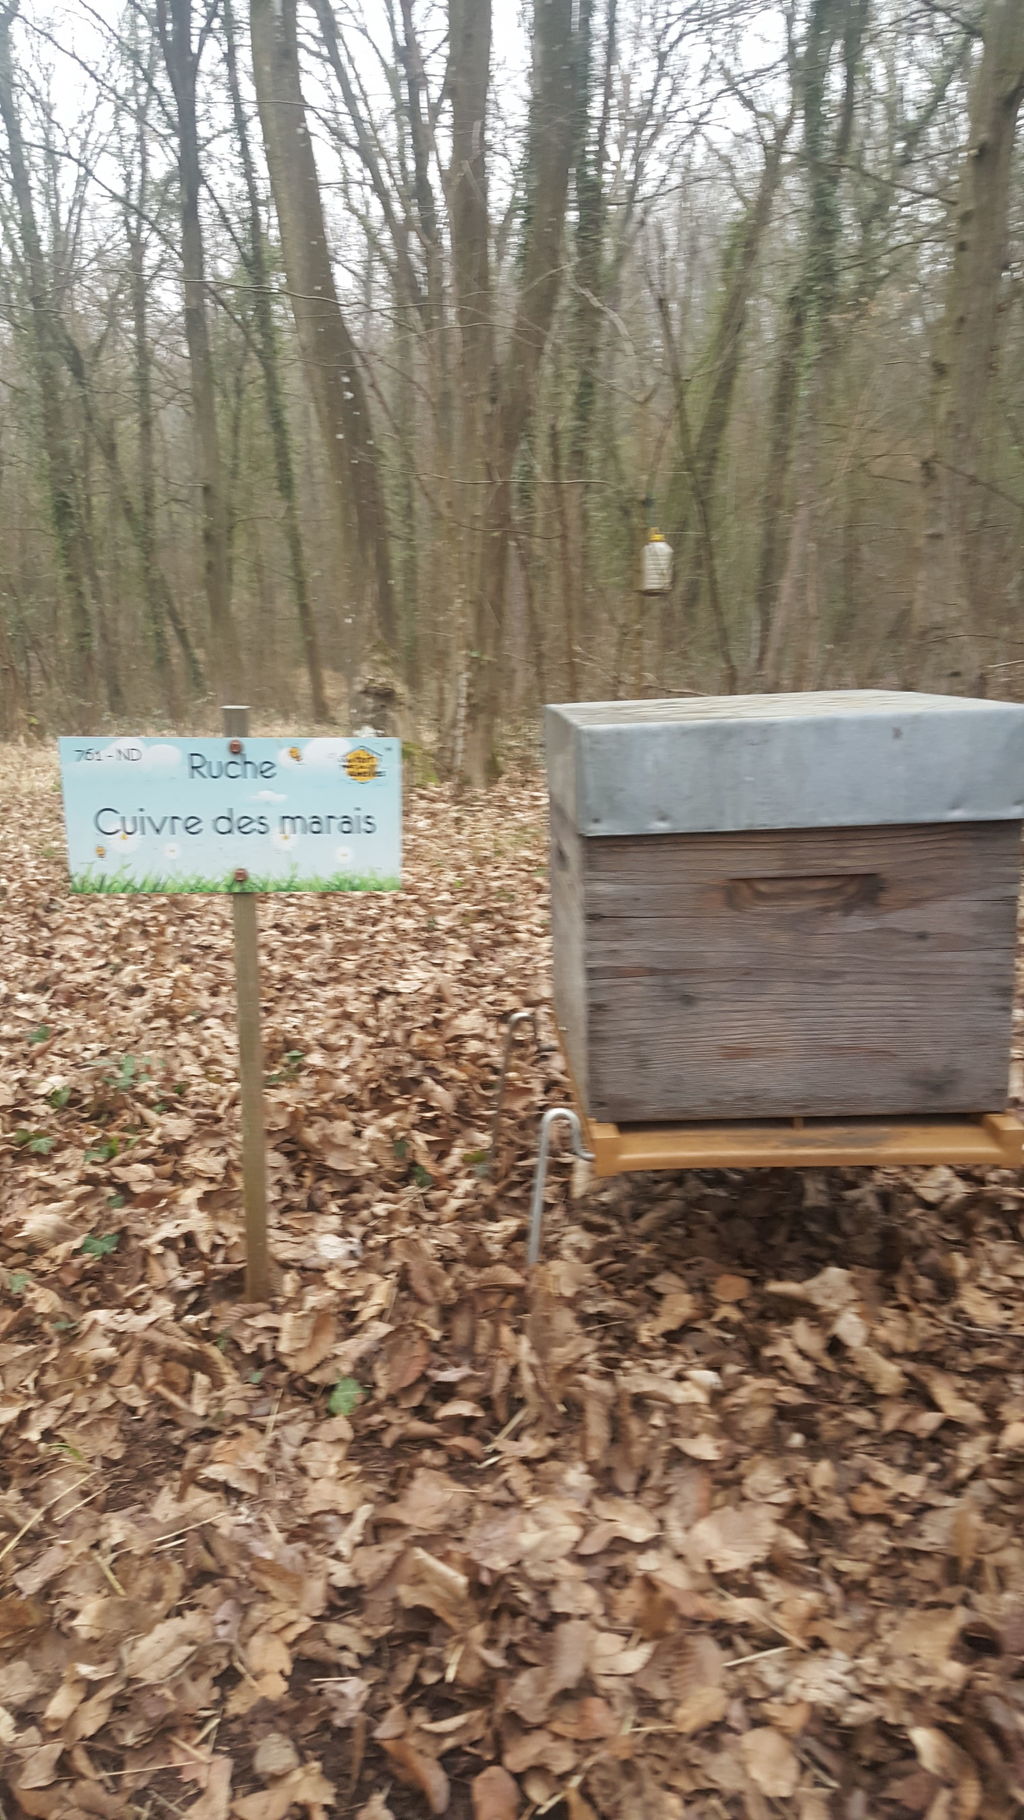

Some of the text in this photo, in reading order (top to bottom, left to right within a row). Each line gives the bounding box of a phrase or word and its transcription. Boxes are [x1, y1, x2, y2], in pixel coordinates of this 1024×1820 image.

[74, 748, 102, 762] 761
[117, 748, 143, 761] ND
[188, 752, 277, 779] Ruche
[94, 807, 377, 836] Cuivre des marais
